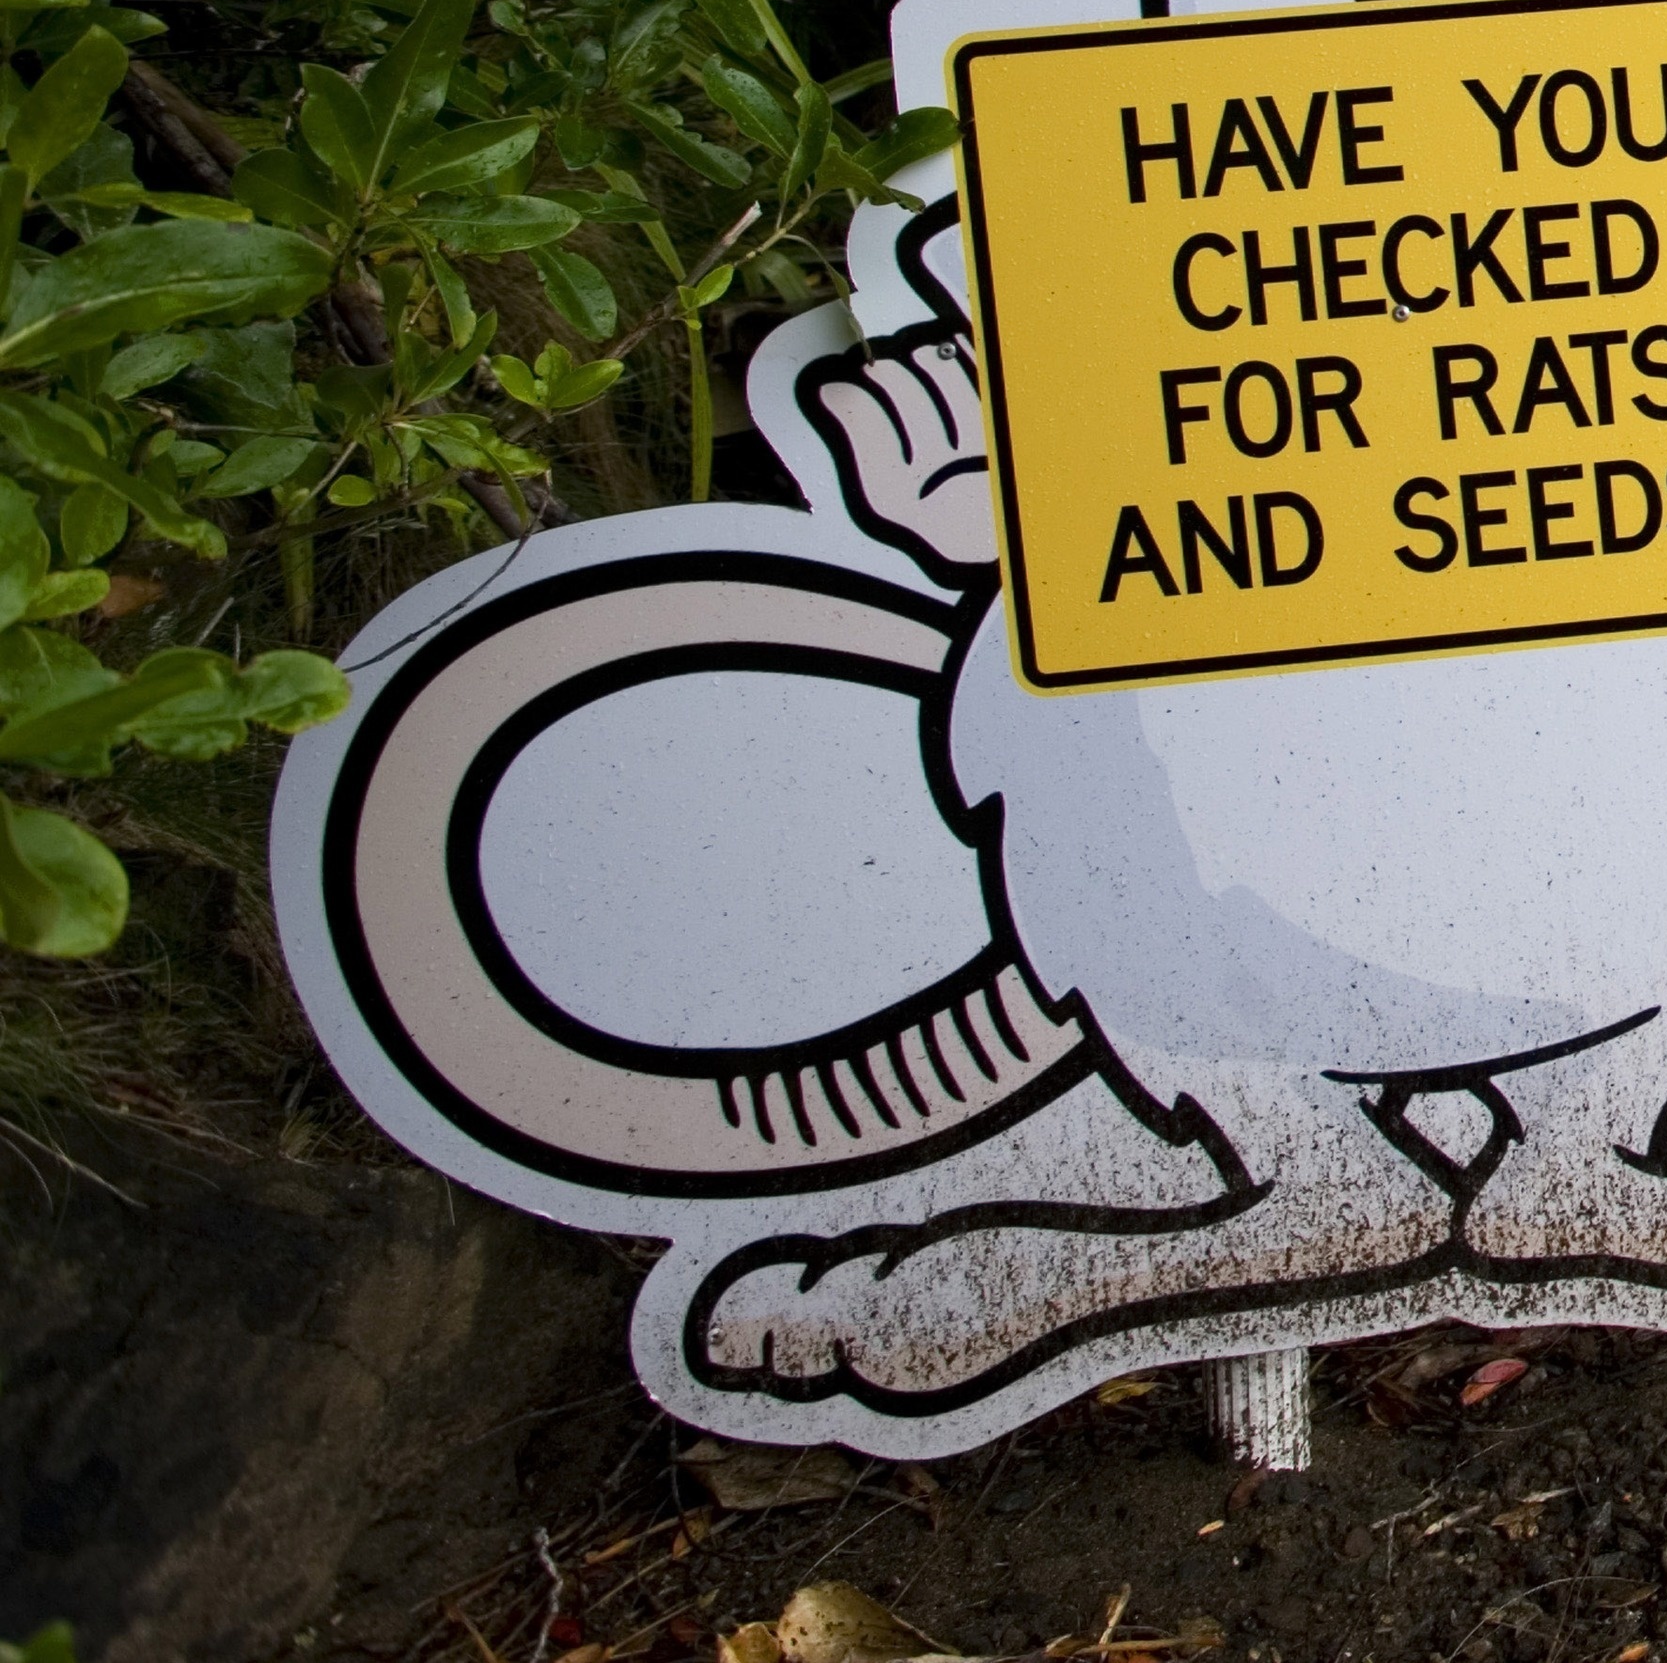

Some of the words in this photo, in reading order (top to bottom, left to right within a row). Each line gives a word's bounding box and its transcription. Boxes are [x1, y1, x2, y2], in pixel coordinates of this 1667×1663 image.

[1121, 87, 1405, 204] HAVE
[1172, 199, 1659, 332] CHECKED
[1160, 355, 1371, 466] FOR
[1098, 491, 1324, 604] AND
